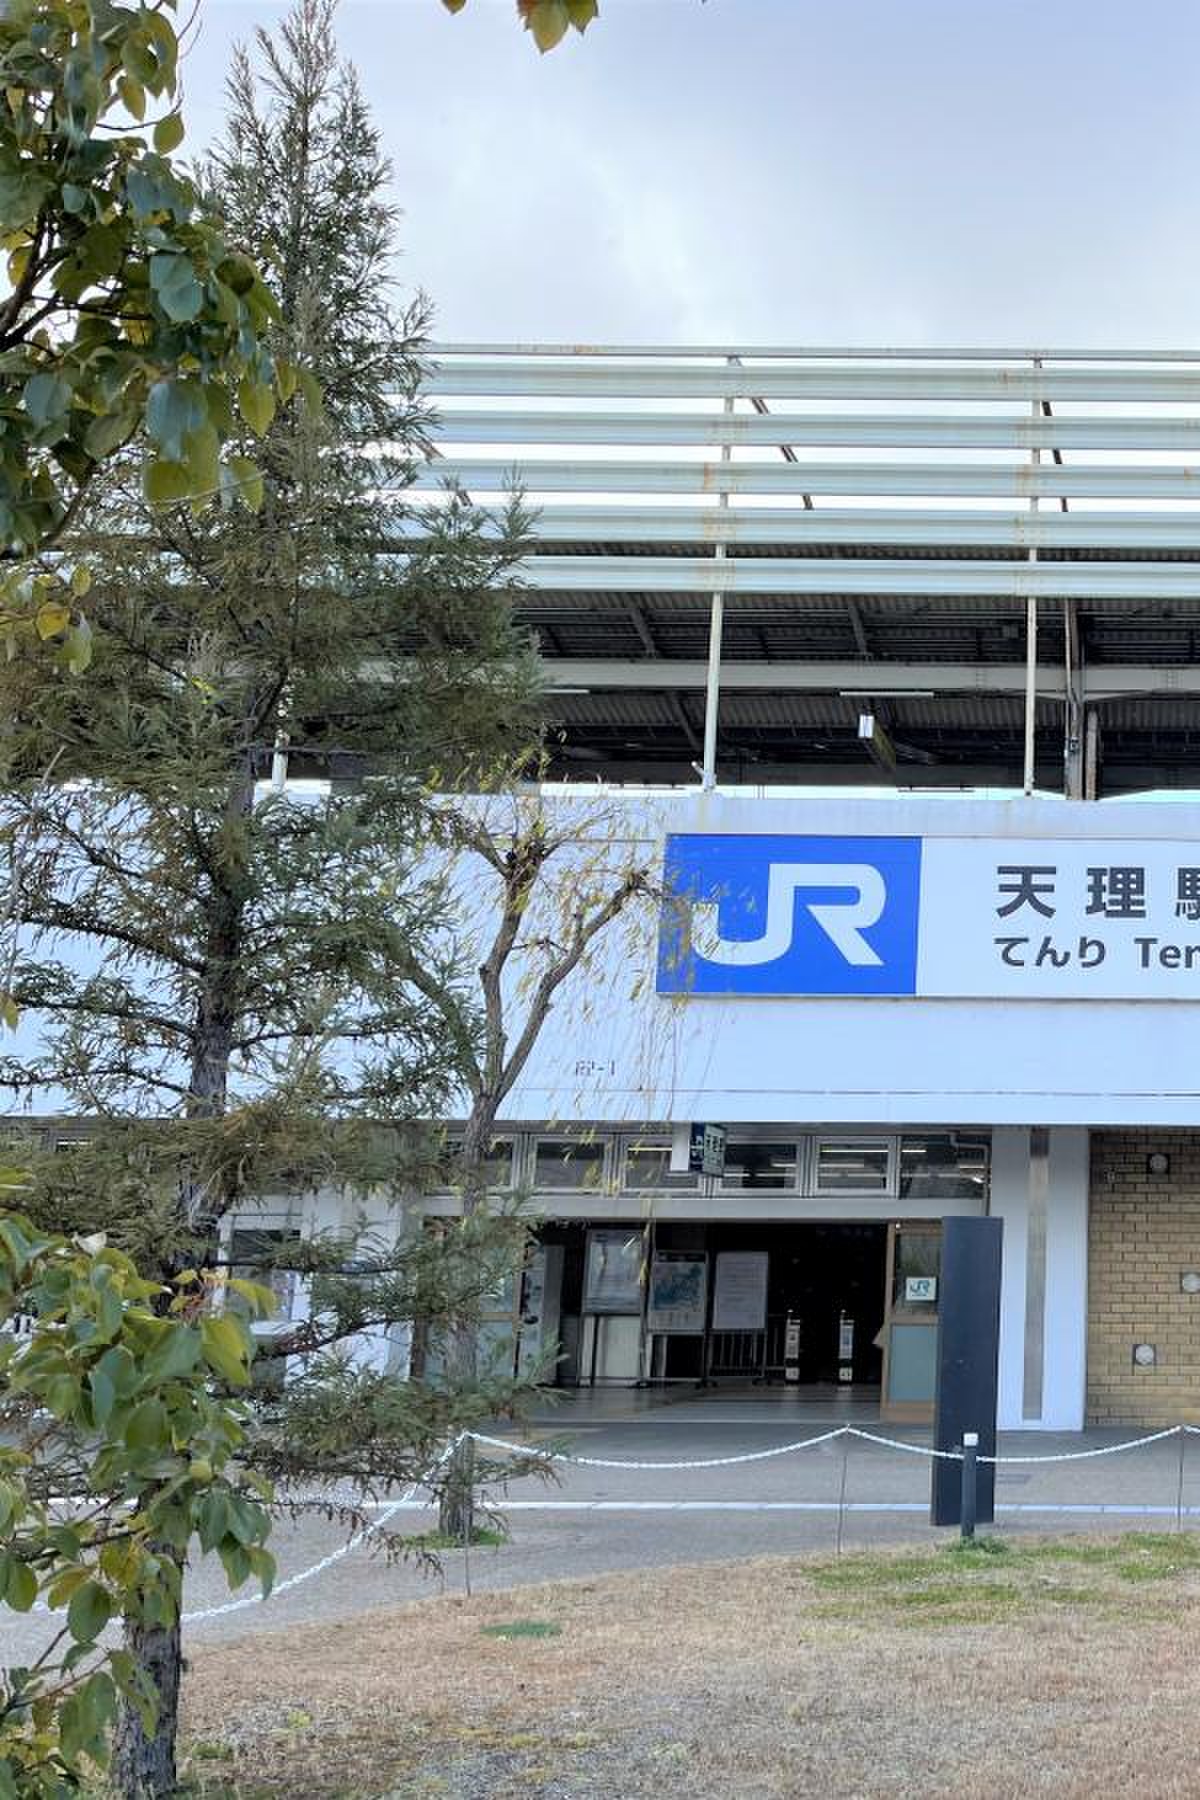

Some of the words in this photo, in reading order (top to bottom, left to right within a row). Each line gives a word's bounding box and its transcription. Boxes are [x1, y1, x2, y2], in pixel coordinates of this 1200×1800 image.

[690, 863, 885, 966] JR
[993, 936, 1106, 969] てんり
